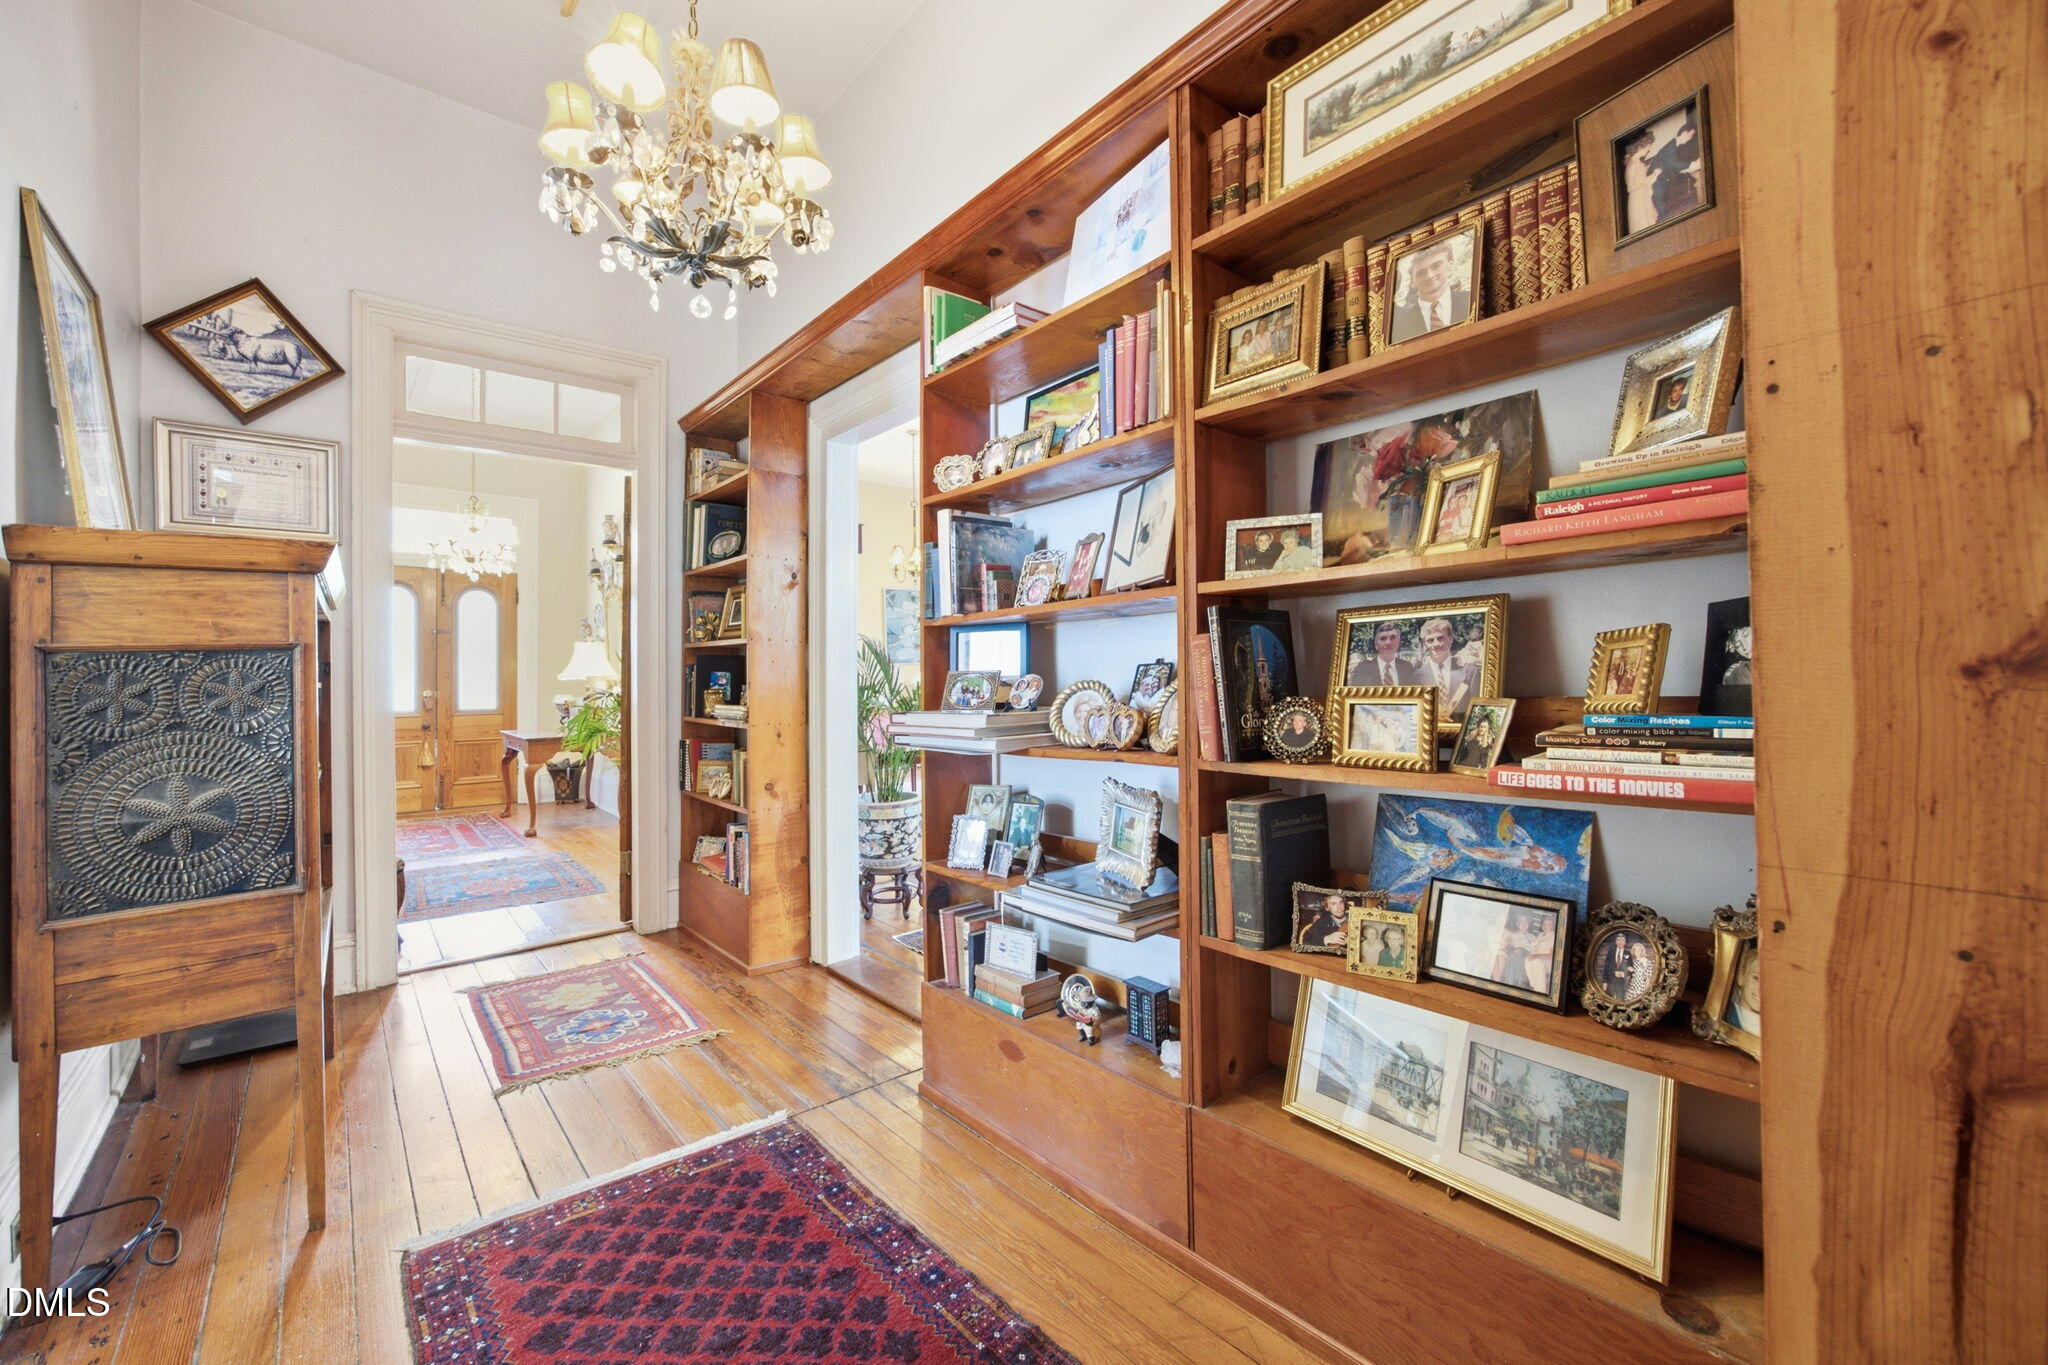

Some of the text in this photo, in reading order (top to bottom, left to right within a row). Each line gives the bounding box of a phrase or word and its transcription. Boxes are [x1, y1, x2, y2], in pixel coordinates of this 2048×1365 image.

[1594, 457, 1633, 468] Growing
[1661, 443, 1702, 455] Raleigh
[1544, 501, 1585, 516] Raleigh
[1593, 497, 1621, 506] PICTORIAL
[1622, 493, 1648, 502] HISTORY
[1514, 509, 1665, 538] RICHARD KEITH LANGHAM
[1591, 716, 1616, 724] Color
[1617, 716, 1648, 725] Mixing
[1649, 717, 1691, 726] Recipes
[1653, 728, 1675, 736] bible
[1545, 736, 1580, 744] Mastering
[1581, 736, 1602, 744] Color
[1499, 771, 1685, 799] LIFE GOES TO THE MOVIES
